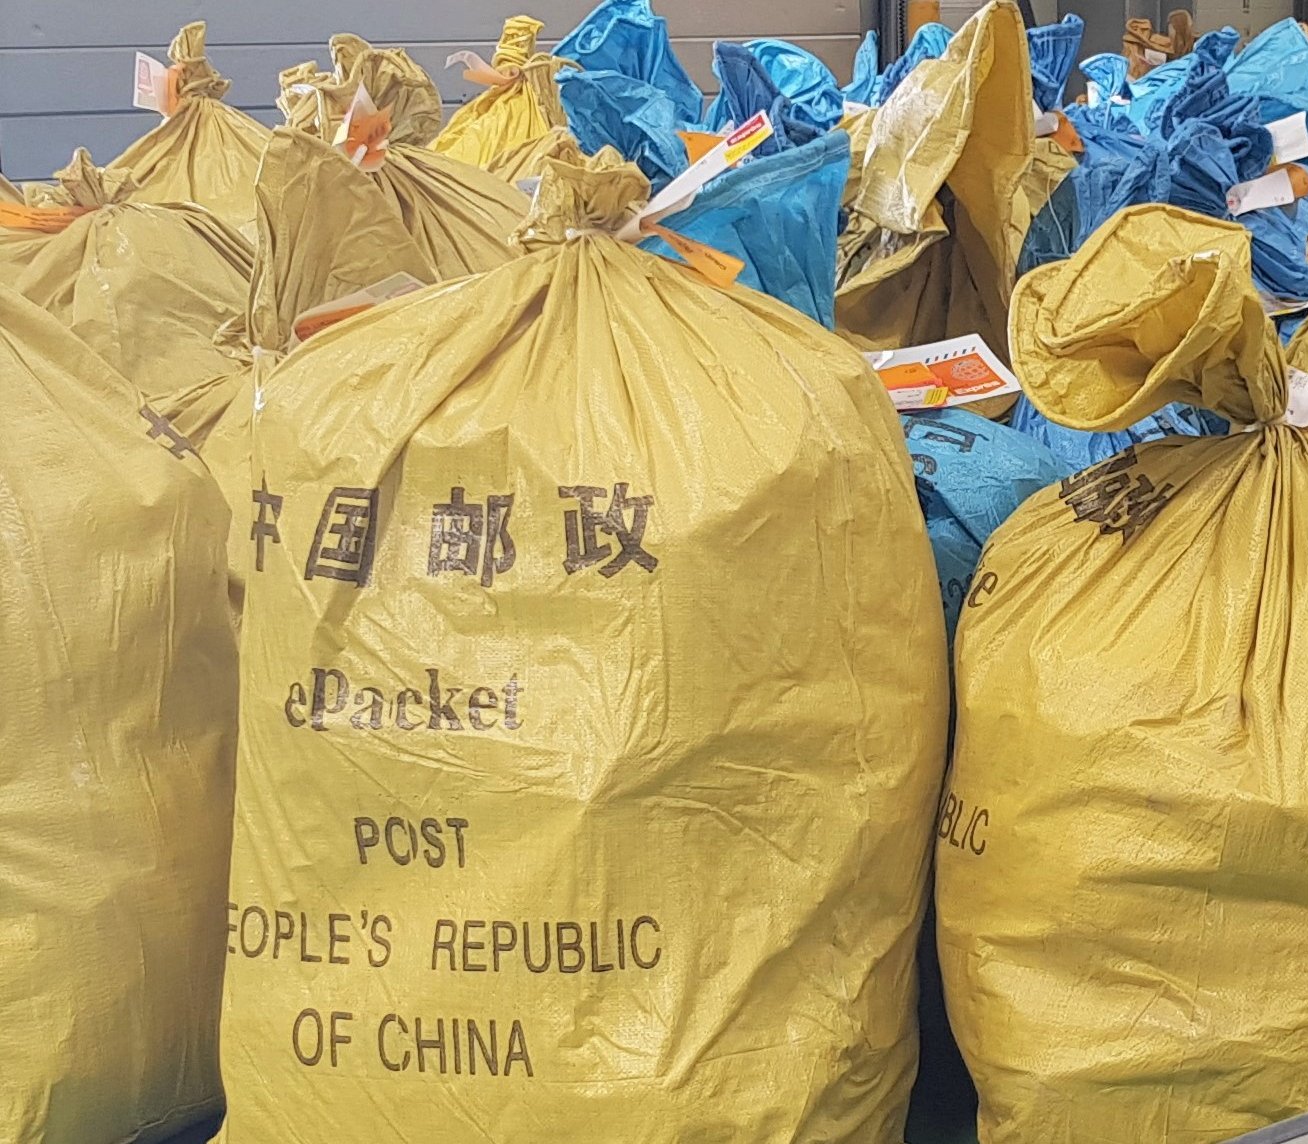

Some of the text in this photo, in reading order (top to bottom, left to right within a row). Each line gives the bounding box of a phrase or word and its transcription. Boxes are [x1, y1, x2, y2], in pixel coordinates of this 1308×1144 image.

[285, 667, 525, 732] ePacket
[354, 816, 469, 869] POST
[431, 915, 662, 974] REPUBLIC
[292, 1008, 534, 1078] OF CHINA
